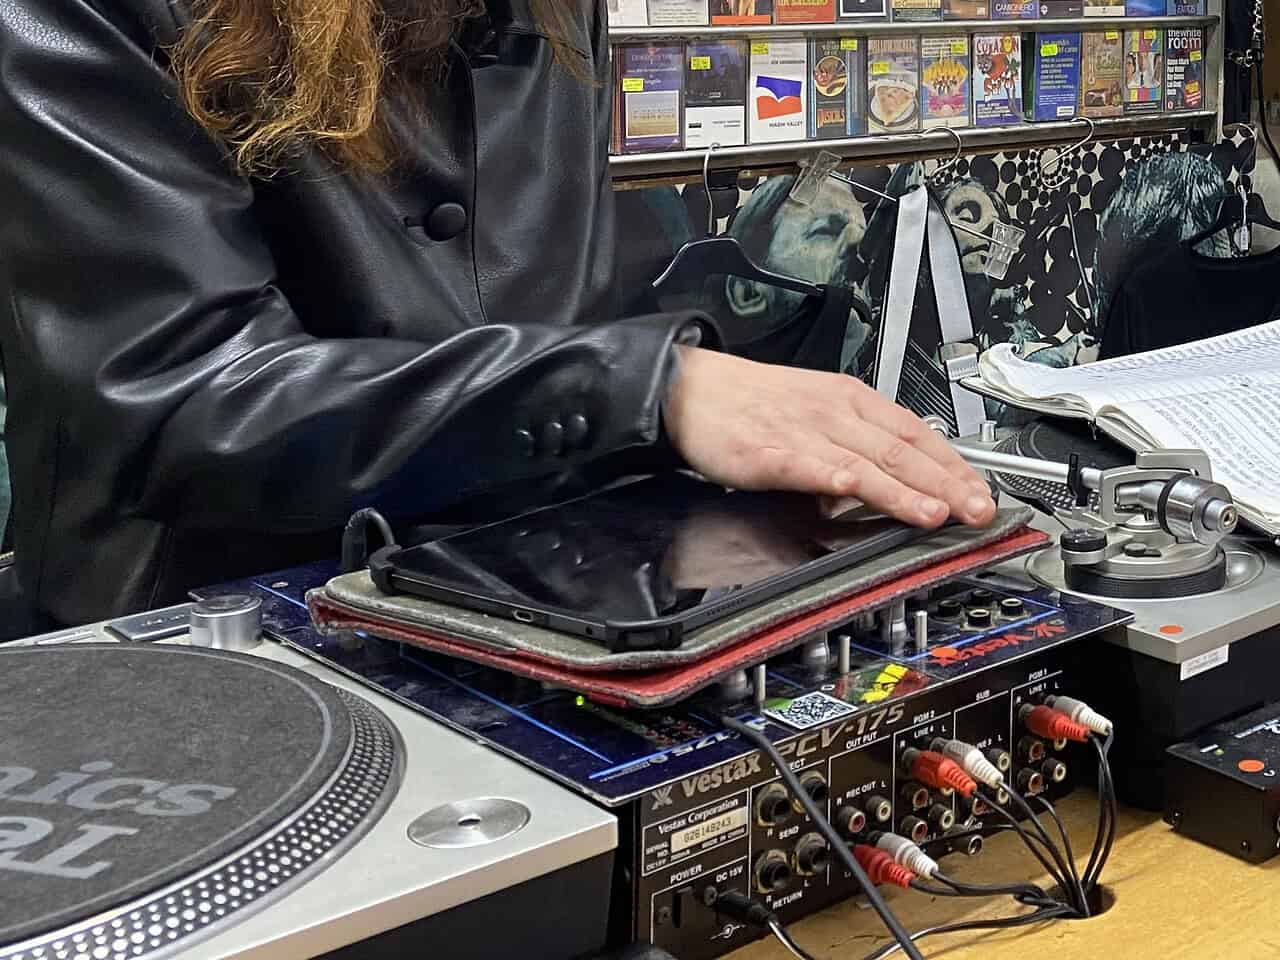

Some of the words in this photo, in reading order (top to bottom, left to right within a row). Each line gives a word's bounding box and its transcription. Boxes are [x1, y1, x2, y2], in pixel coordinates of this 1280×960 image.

[1167, 36, 1201, 50] room
[846, 735, 863, 750] OUT
[863, 730, 878, 745] PUT
[658, 816, 687, 836] Vestax
[687, 798, 739, 825] Corporation
[778, 825, 800, 841] SEND
[669, 864, 703, 885] POWER
